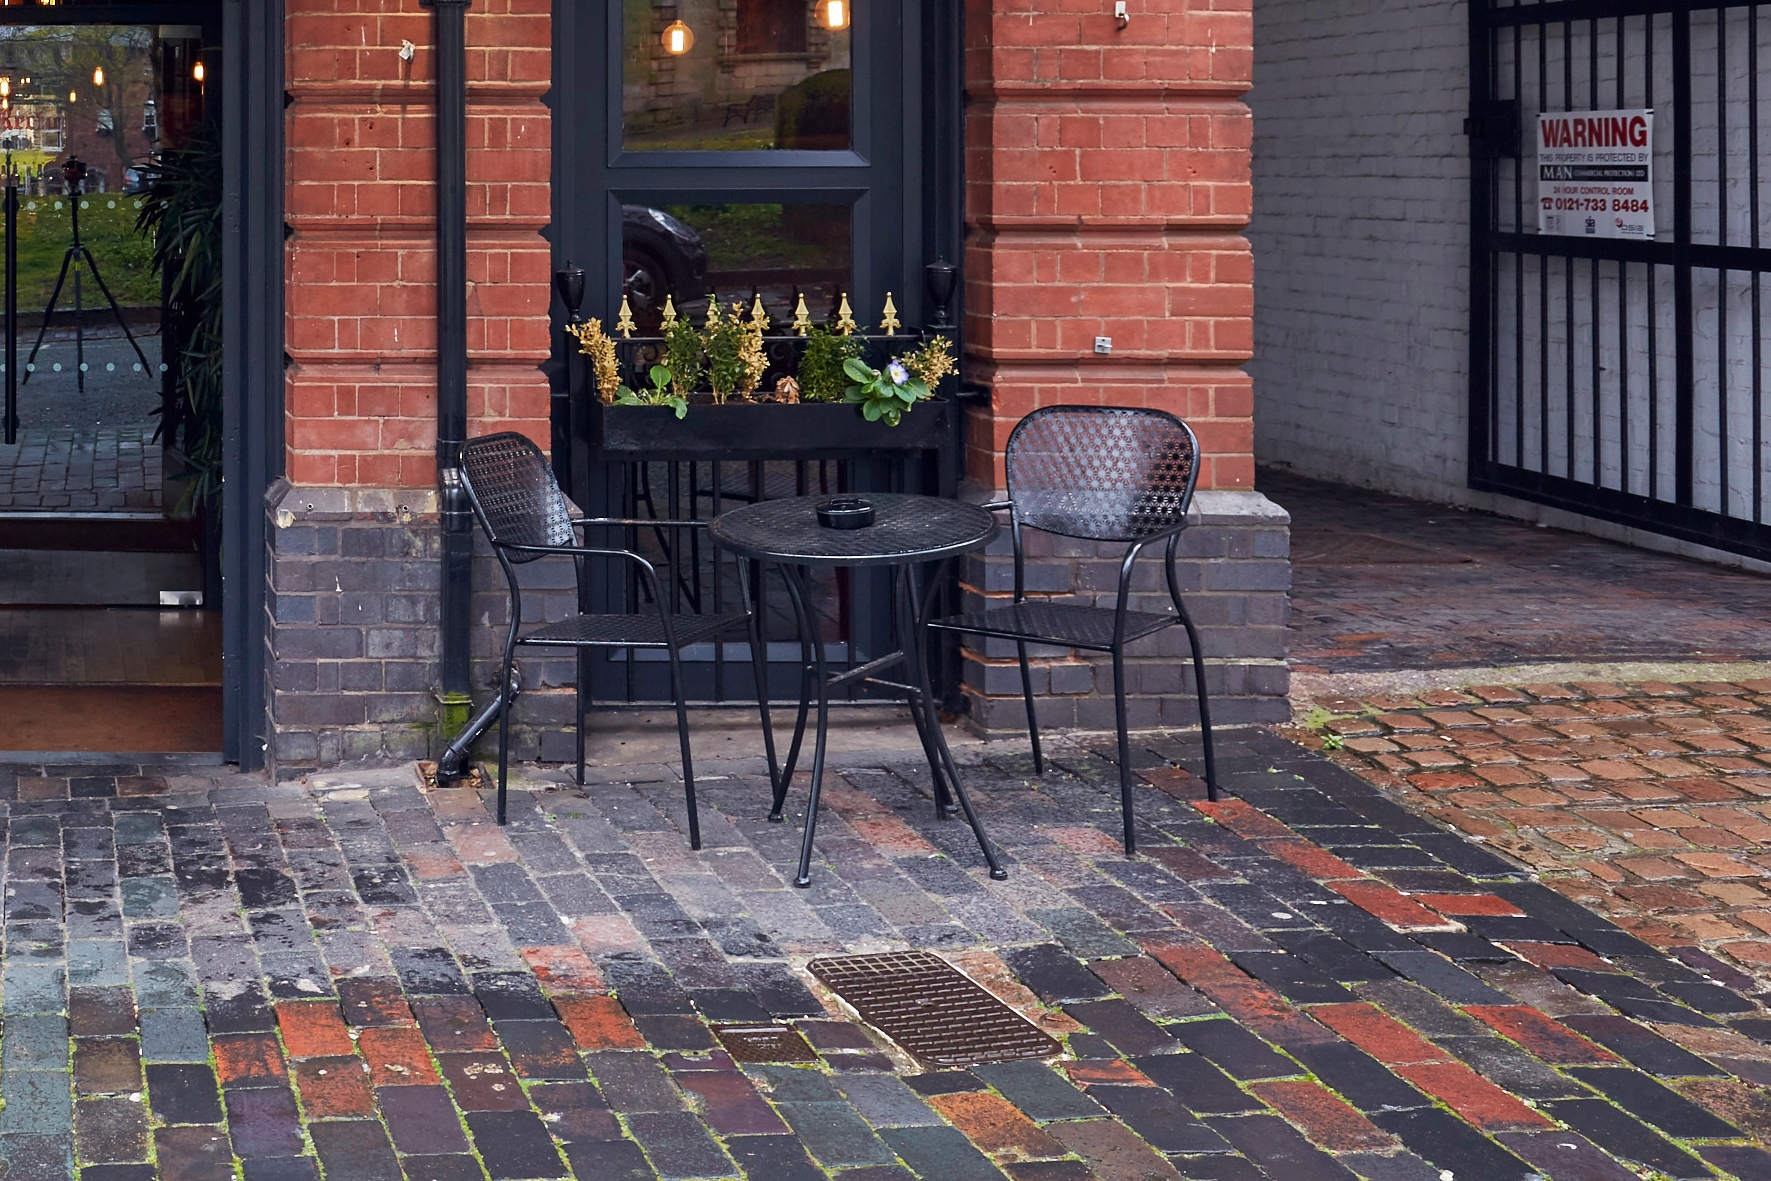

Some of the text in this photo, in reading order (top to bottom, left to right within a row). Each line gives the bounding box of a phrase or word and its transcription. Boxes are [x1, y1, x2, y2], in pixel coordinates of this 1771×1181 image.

[1540, 116, 1648, 148] WARNING
[1540, 153, 1648, 162] THIS PROPERTY IS PROTECTED BY
[1543, 166, 1573, 179] MAN
[1553, 186, 1635, 196] 24 HOUR CONTROL ROOM
[1555, 197, 1649, 213] 0121-733 8484
